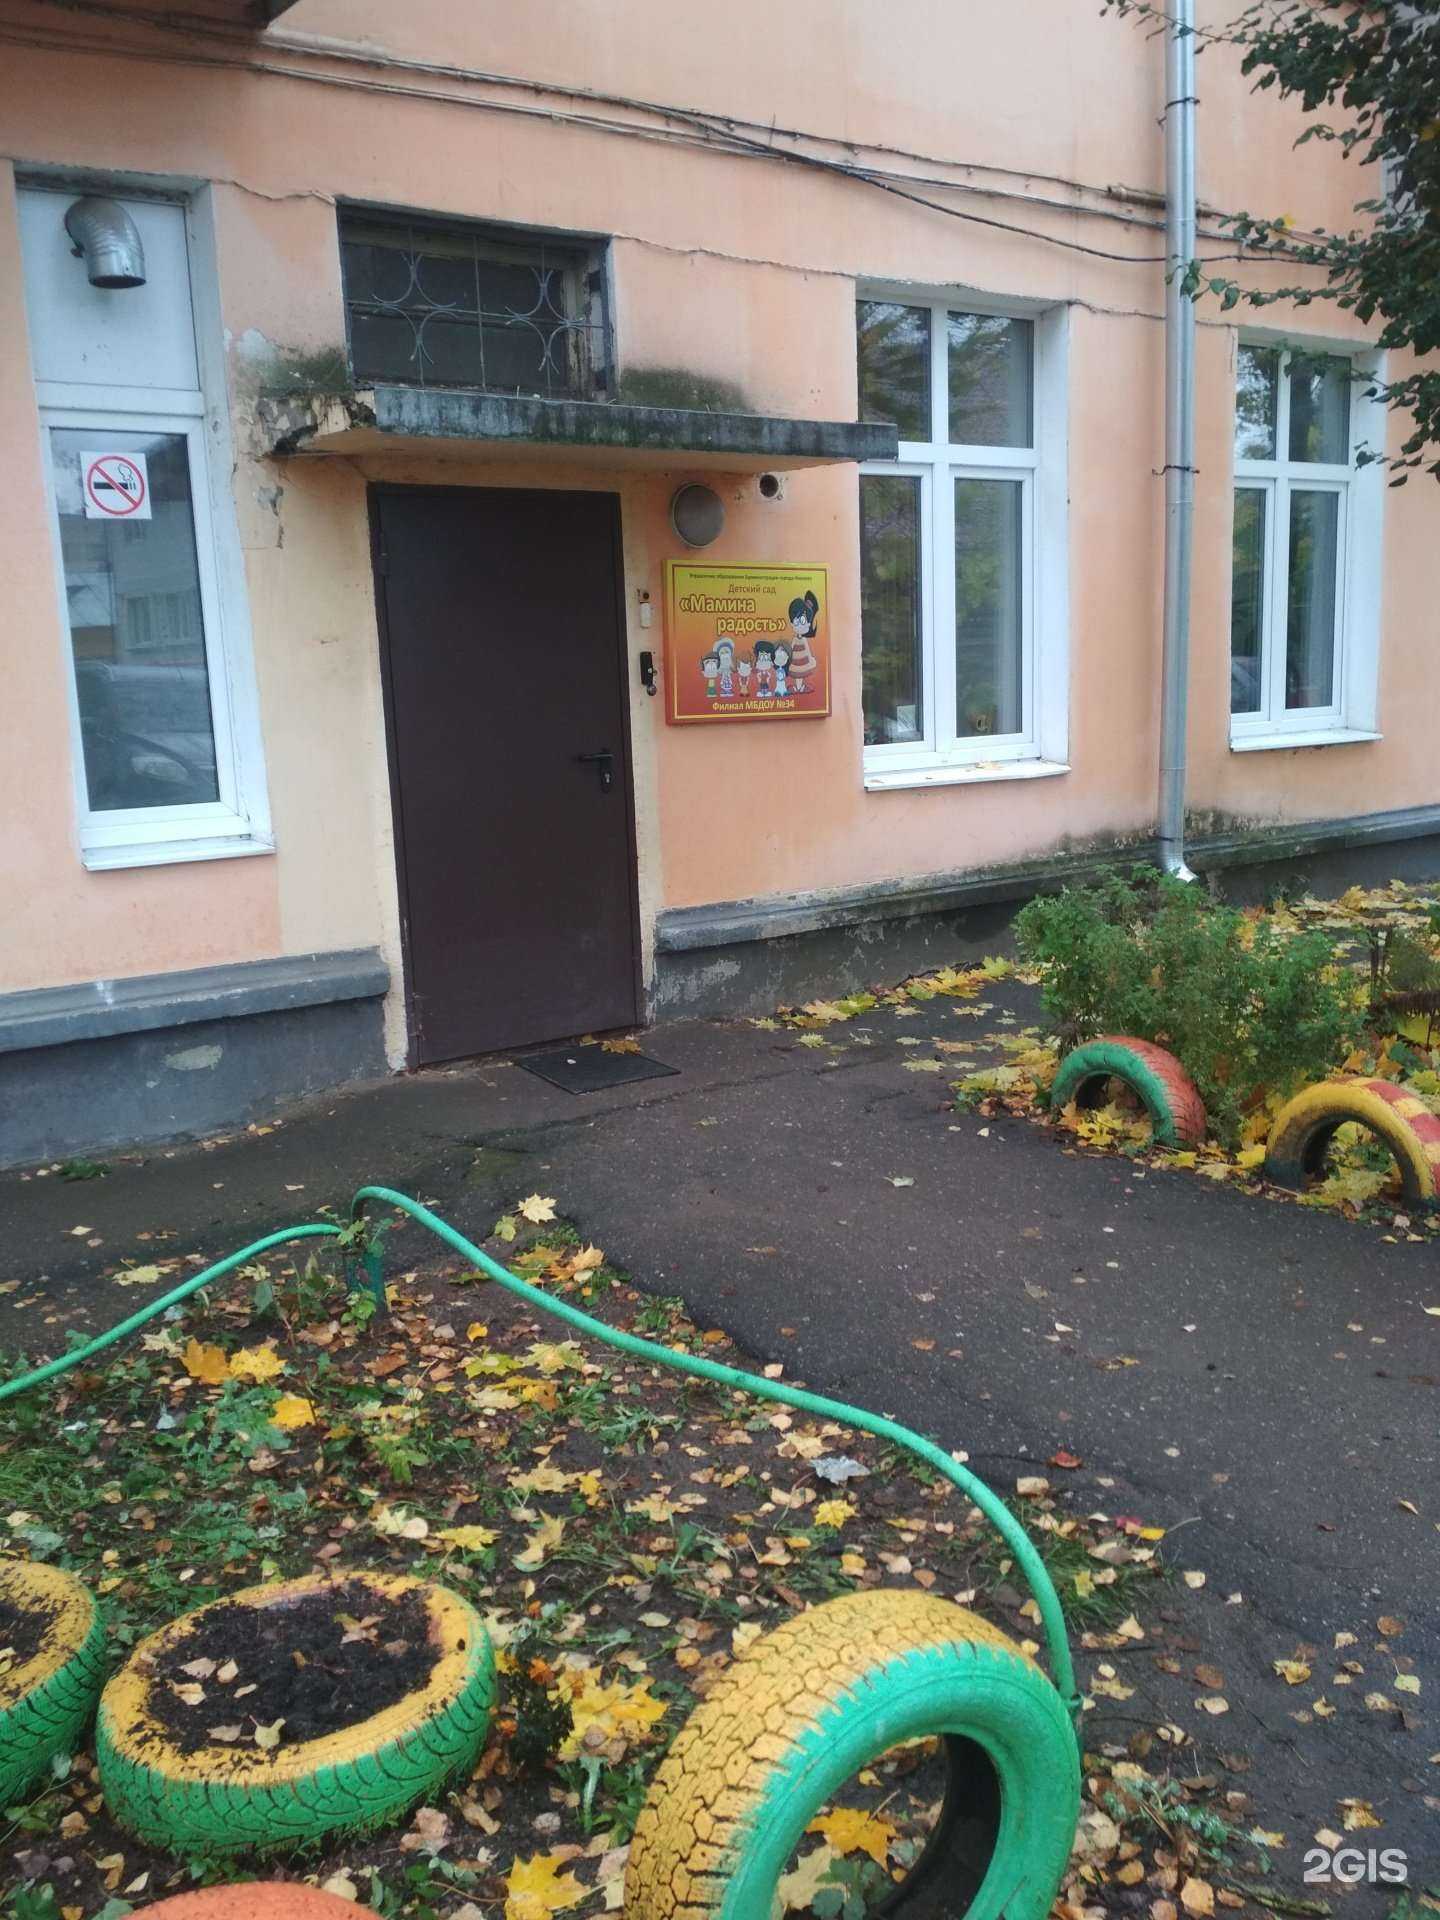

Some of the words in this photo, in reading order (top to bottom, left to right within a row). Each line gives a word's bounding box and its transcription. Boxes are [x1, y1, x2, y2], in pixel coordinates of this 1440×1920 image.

[728, 583, 761, 594] Детский
[762, 585, 777, 595] сад
[679, 593, 756, 613] «Мамина
[716, 617, 786, 636] радость»
[712, 702, 744, 711] Филиал
[745, 700, 775, 711] МБДОУ
[776, 700, 795, 709] №34
